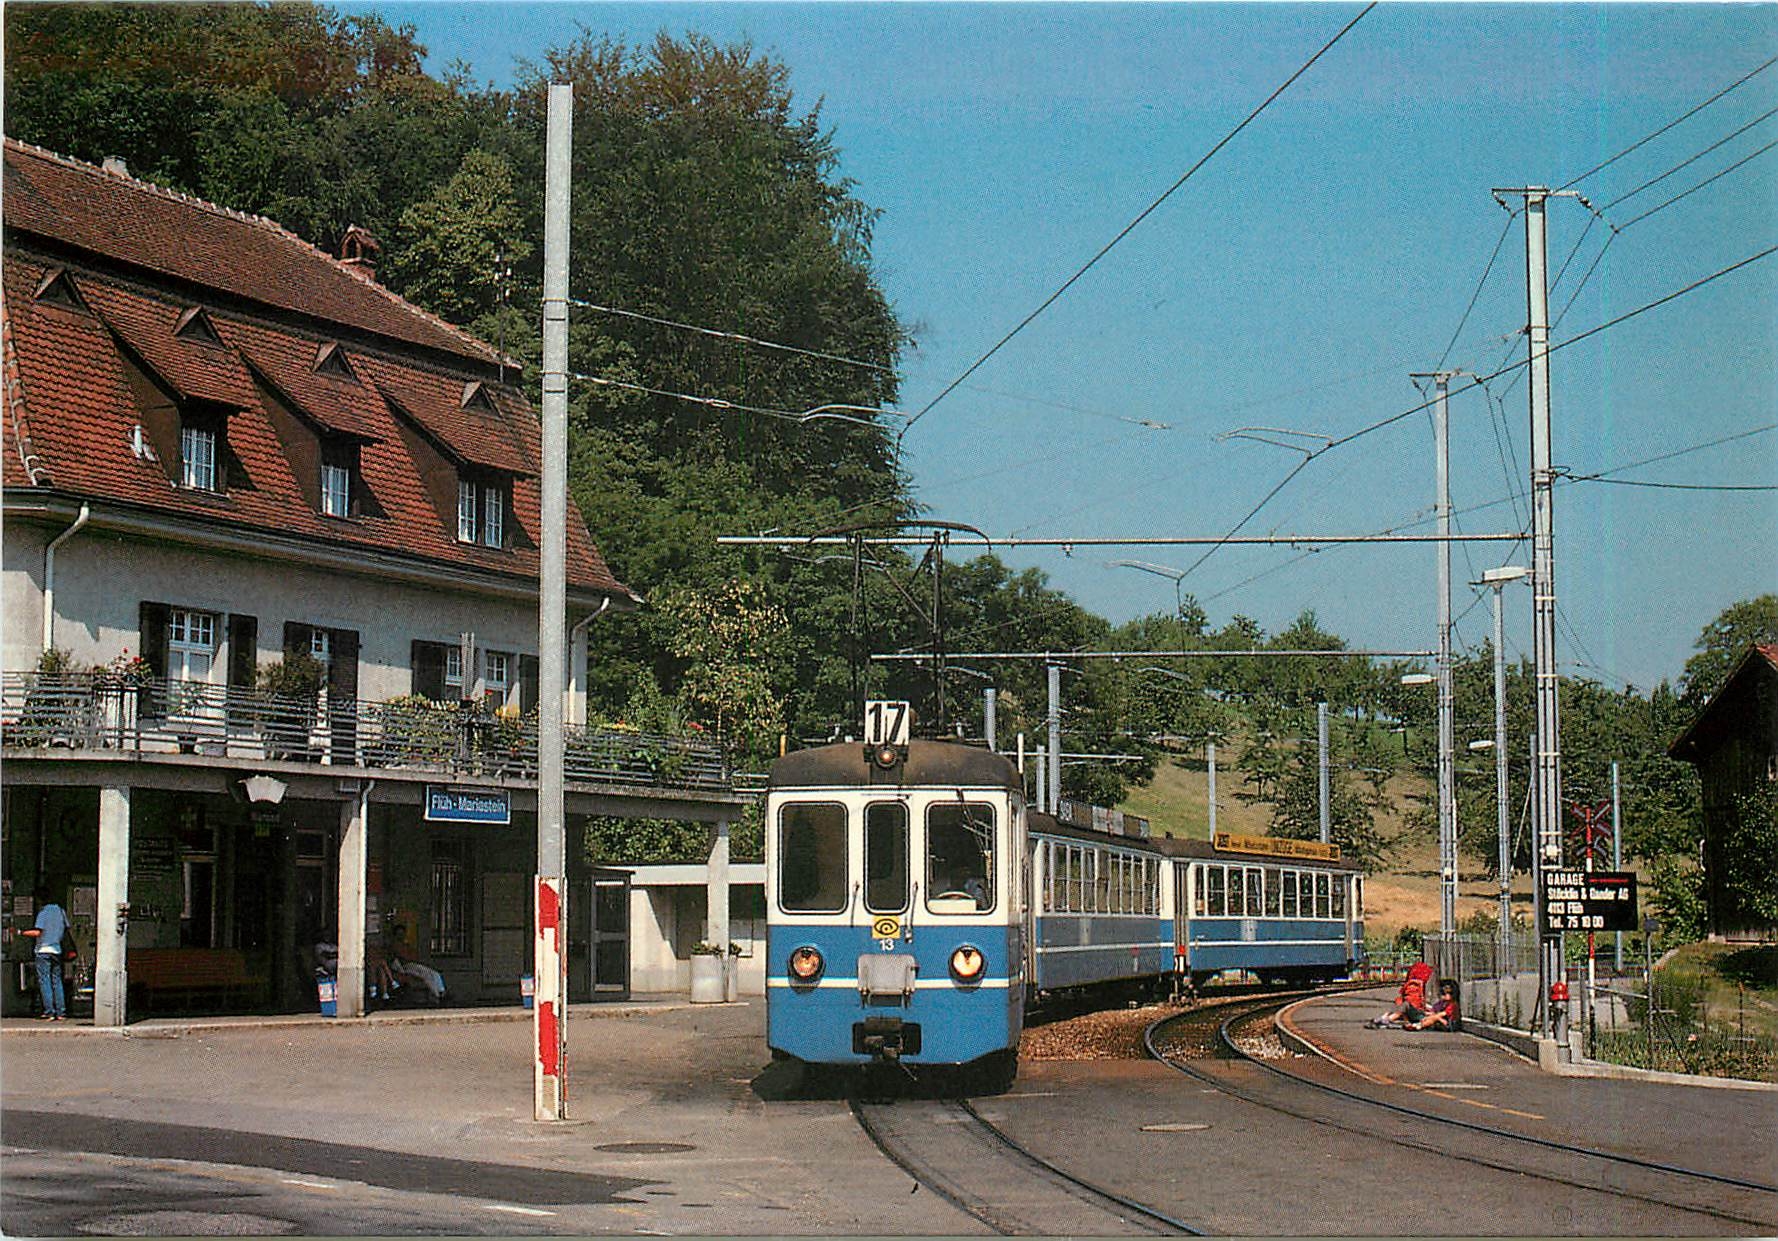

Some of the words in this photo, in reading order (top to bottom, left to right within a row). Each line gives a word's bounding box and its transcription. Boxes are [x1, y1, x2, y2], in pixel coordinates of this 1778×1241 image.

[868, 702, 906, 742] 17
[432, 794, 453, 810] Flüh
[458, 795, 506, 813] Mariastein
[1547, 872, 1585, 886] GARAGE
[1580, 886, 1588, 900] &
[1618, 887, 1629, 900] AG
[1567, 901, 1584, 914] Flüh
[1548, 915, 1564, 928] Tel.
[1566, 915, 1579, 928] 75
[880, 938, 895, 951] 13
